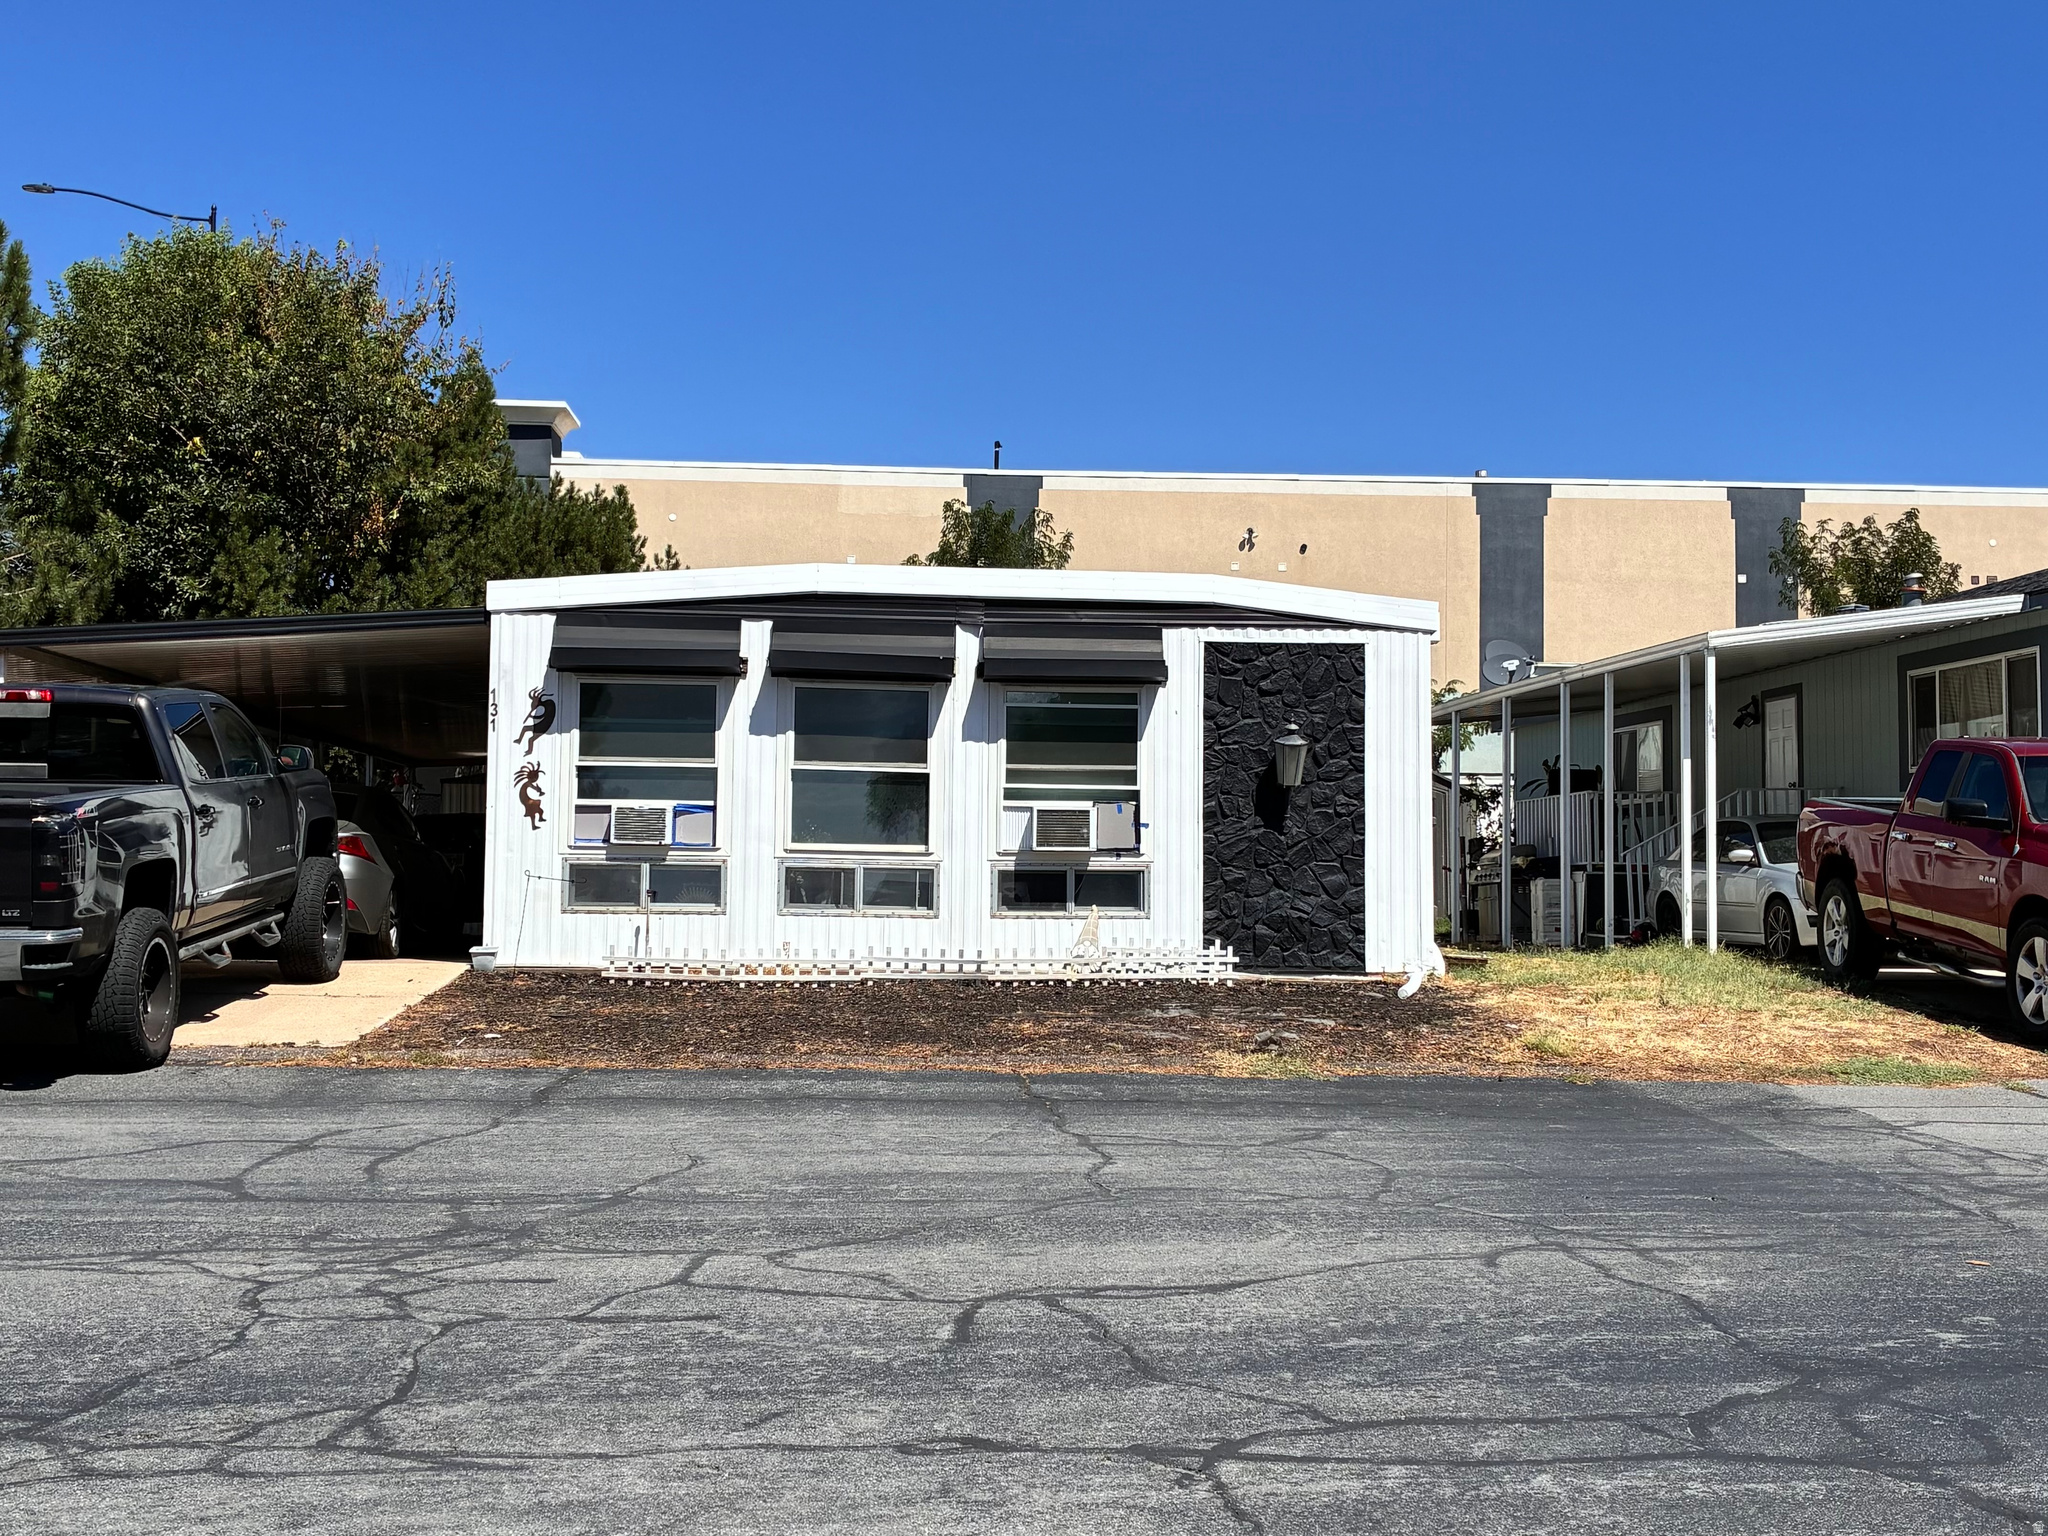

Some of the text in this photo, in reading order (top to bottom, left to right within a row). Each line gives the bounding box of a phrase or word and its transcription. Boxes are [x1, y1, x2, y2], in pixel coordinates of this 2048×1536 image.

[490, 688, 498, 732] 131
[1979, 874, 1996, 884] RAM
[2, 909, 20, 917] LTZ
